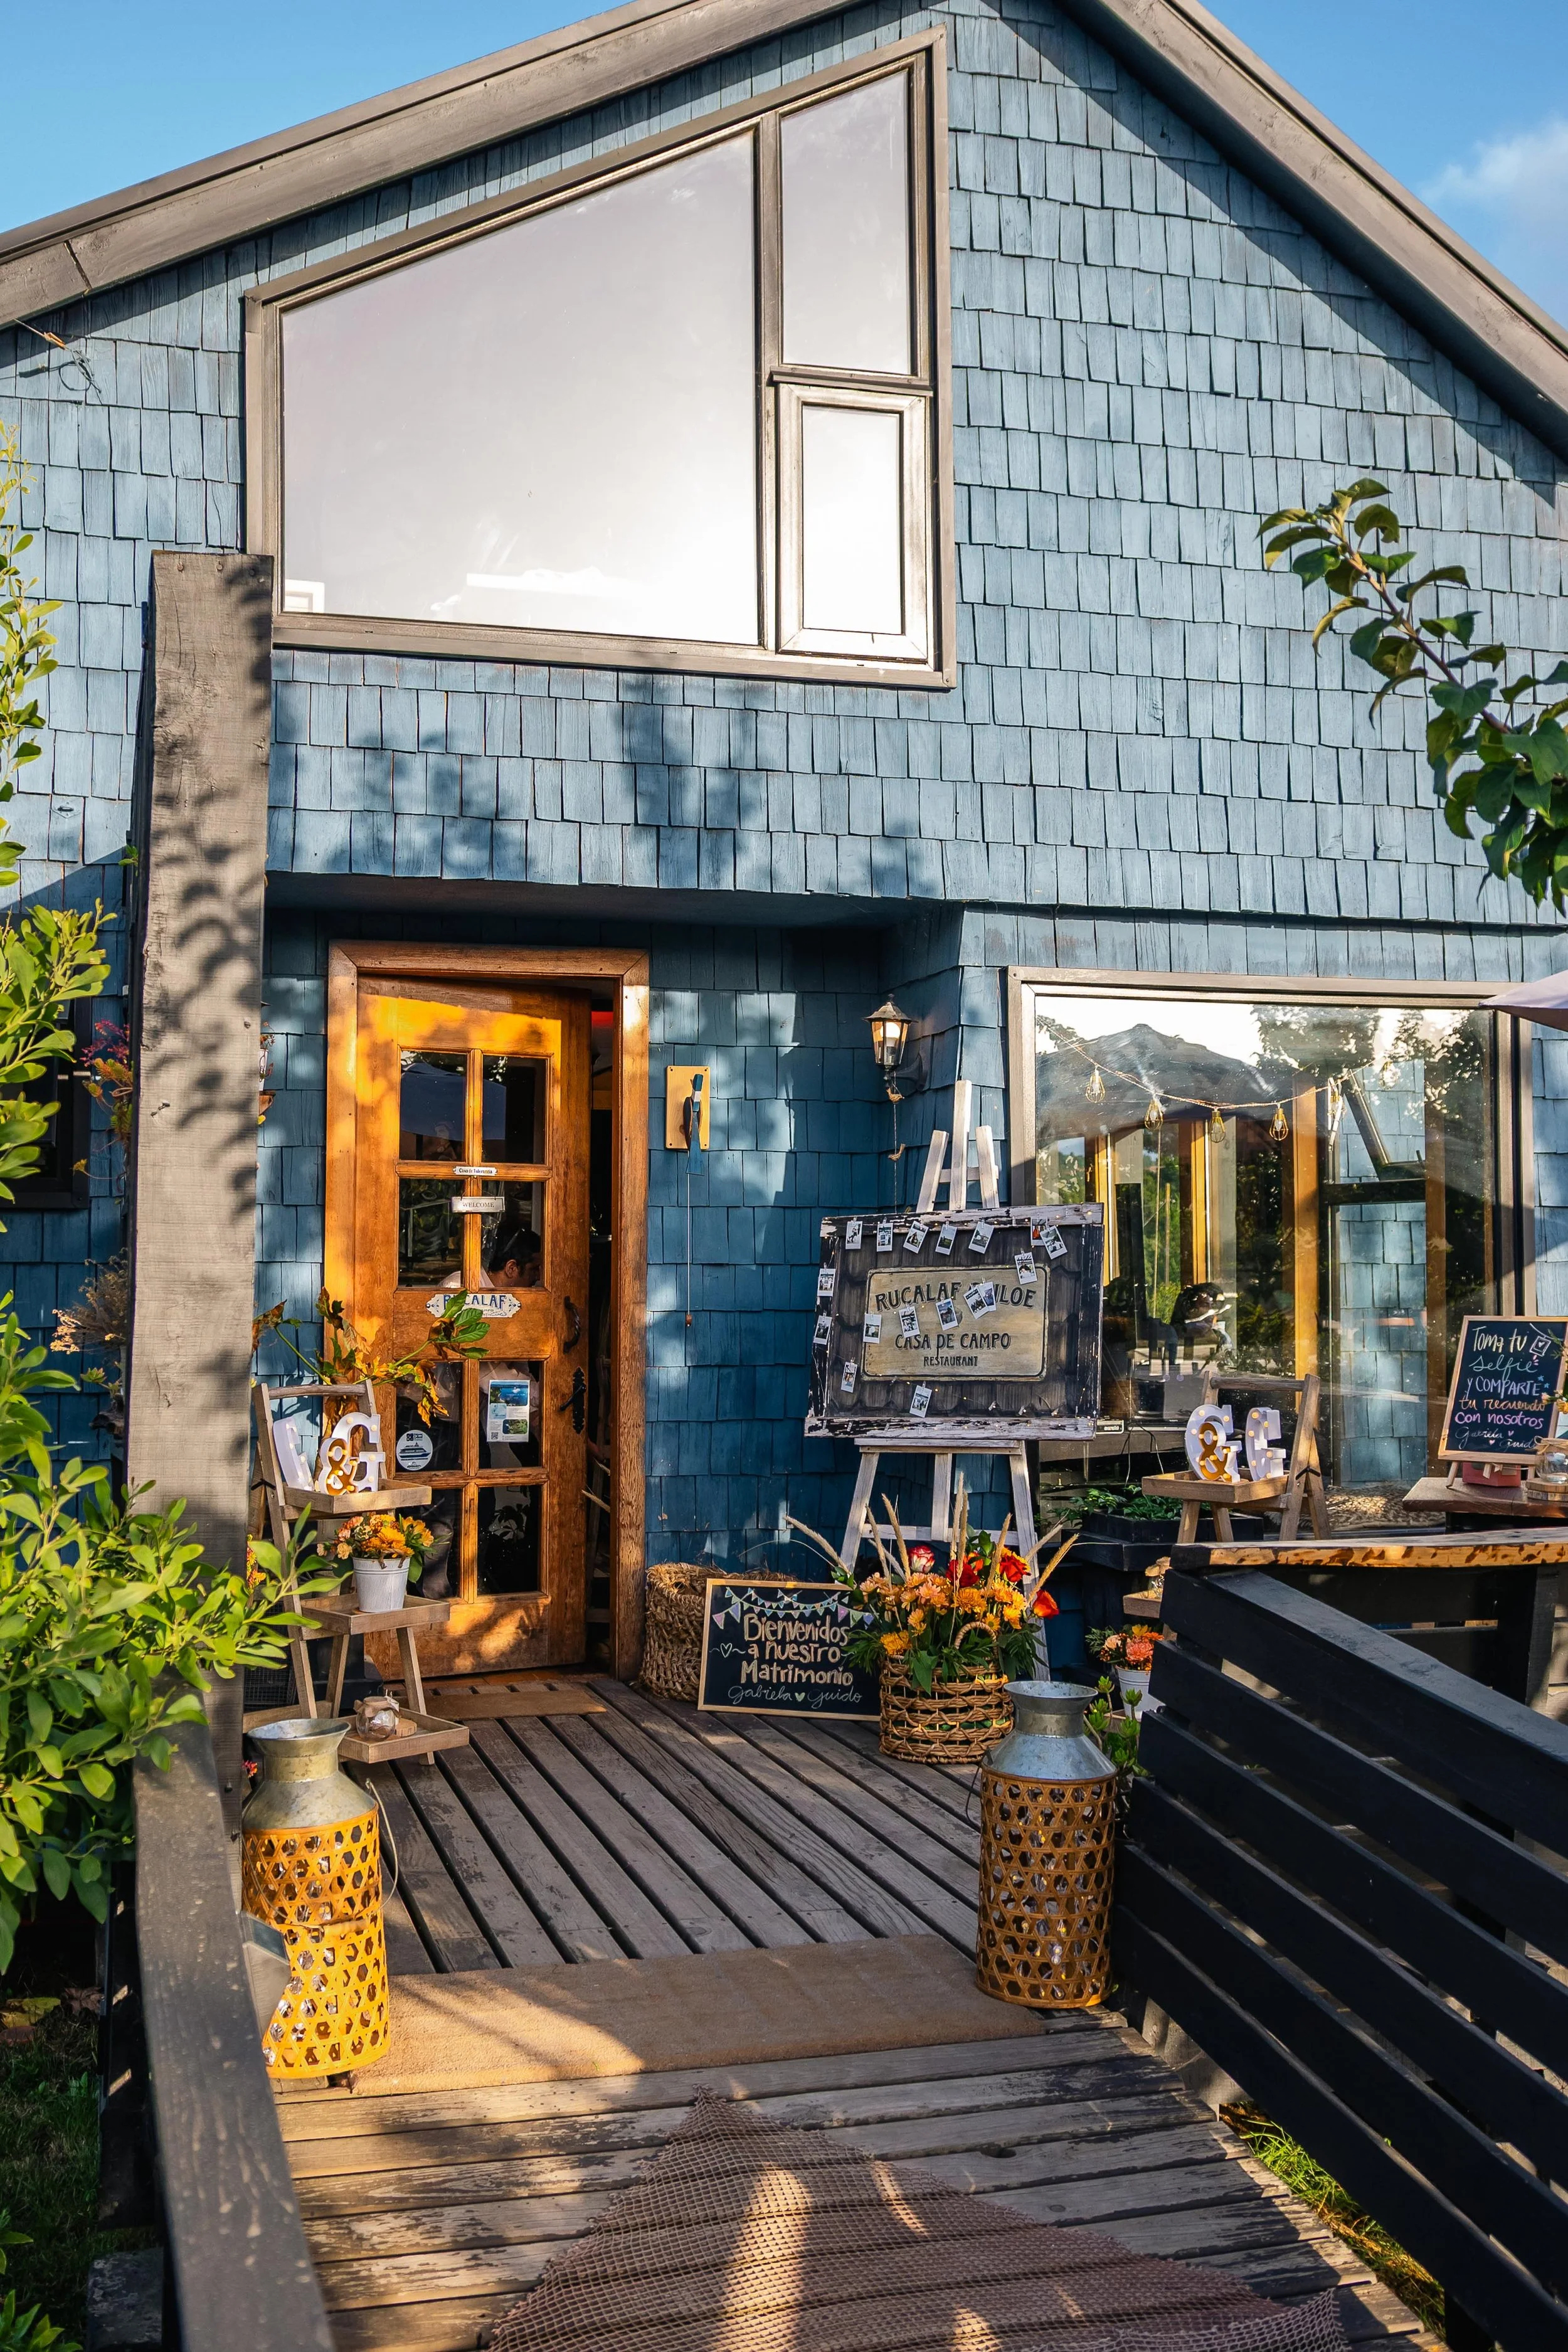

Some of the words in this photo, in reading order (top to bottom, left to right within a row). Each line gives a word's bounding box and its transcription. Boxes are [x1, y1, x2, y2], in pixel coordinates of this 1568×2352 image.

[443, 1295, 507, 1310] RCALAF
[875, 1281, 961, 1312] RUCALAF
[968, 1282, 1037, 1309] ILOE
[895, 1333, 931, 1350] CASA
[936, 1333, 955, 1350] DE
[960, 1332, 1012, 1350] CAMPO
[923, 1355, 978, 1367] RESTAURANT
[1476, 1376, 1541, 1399] COMPARTE
[1459, 1399, 1478, 1411] tu
[1488, 1411, 1545, 1429] nosotros
[743, 1613, 850, 1646] Bienvenidos
[748, 1643, 760, 1659] a
[741, 1660, 854, 1687] Matrimonio
[728, 1685, 792, 1704] Gabriela
[807, 1685, 862, 1709] Guido
